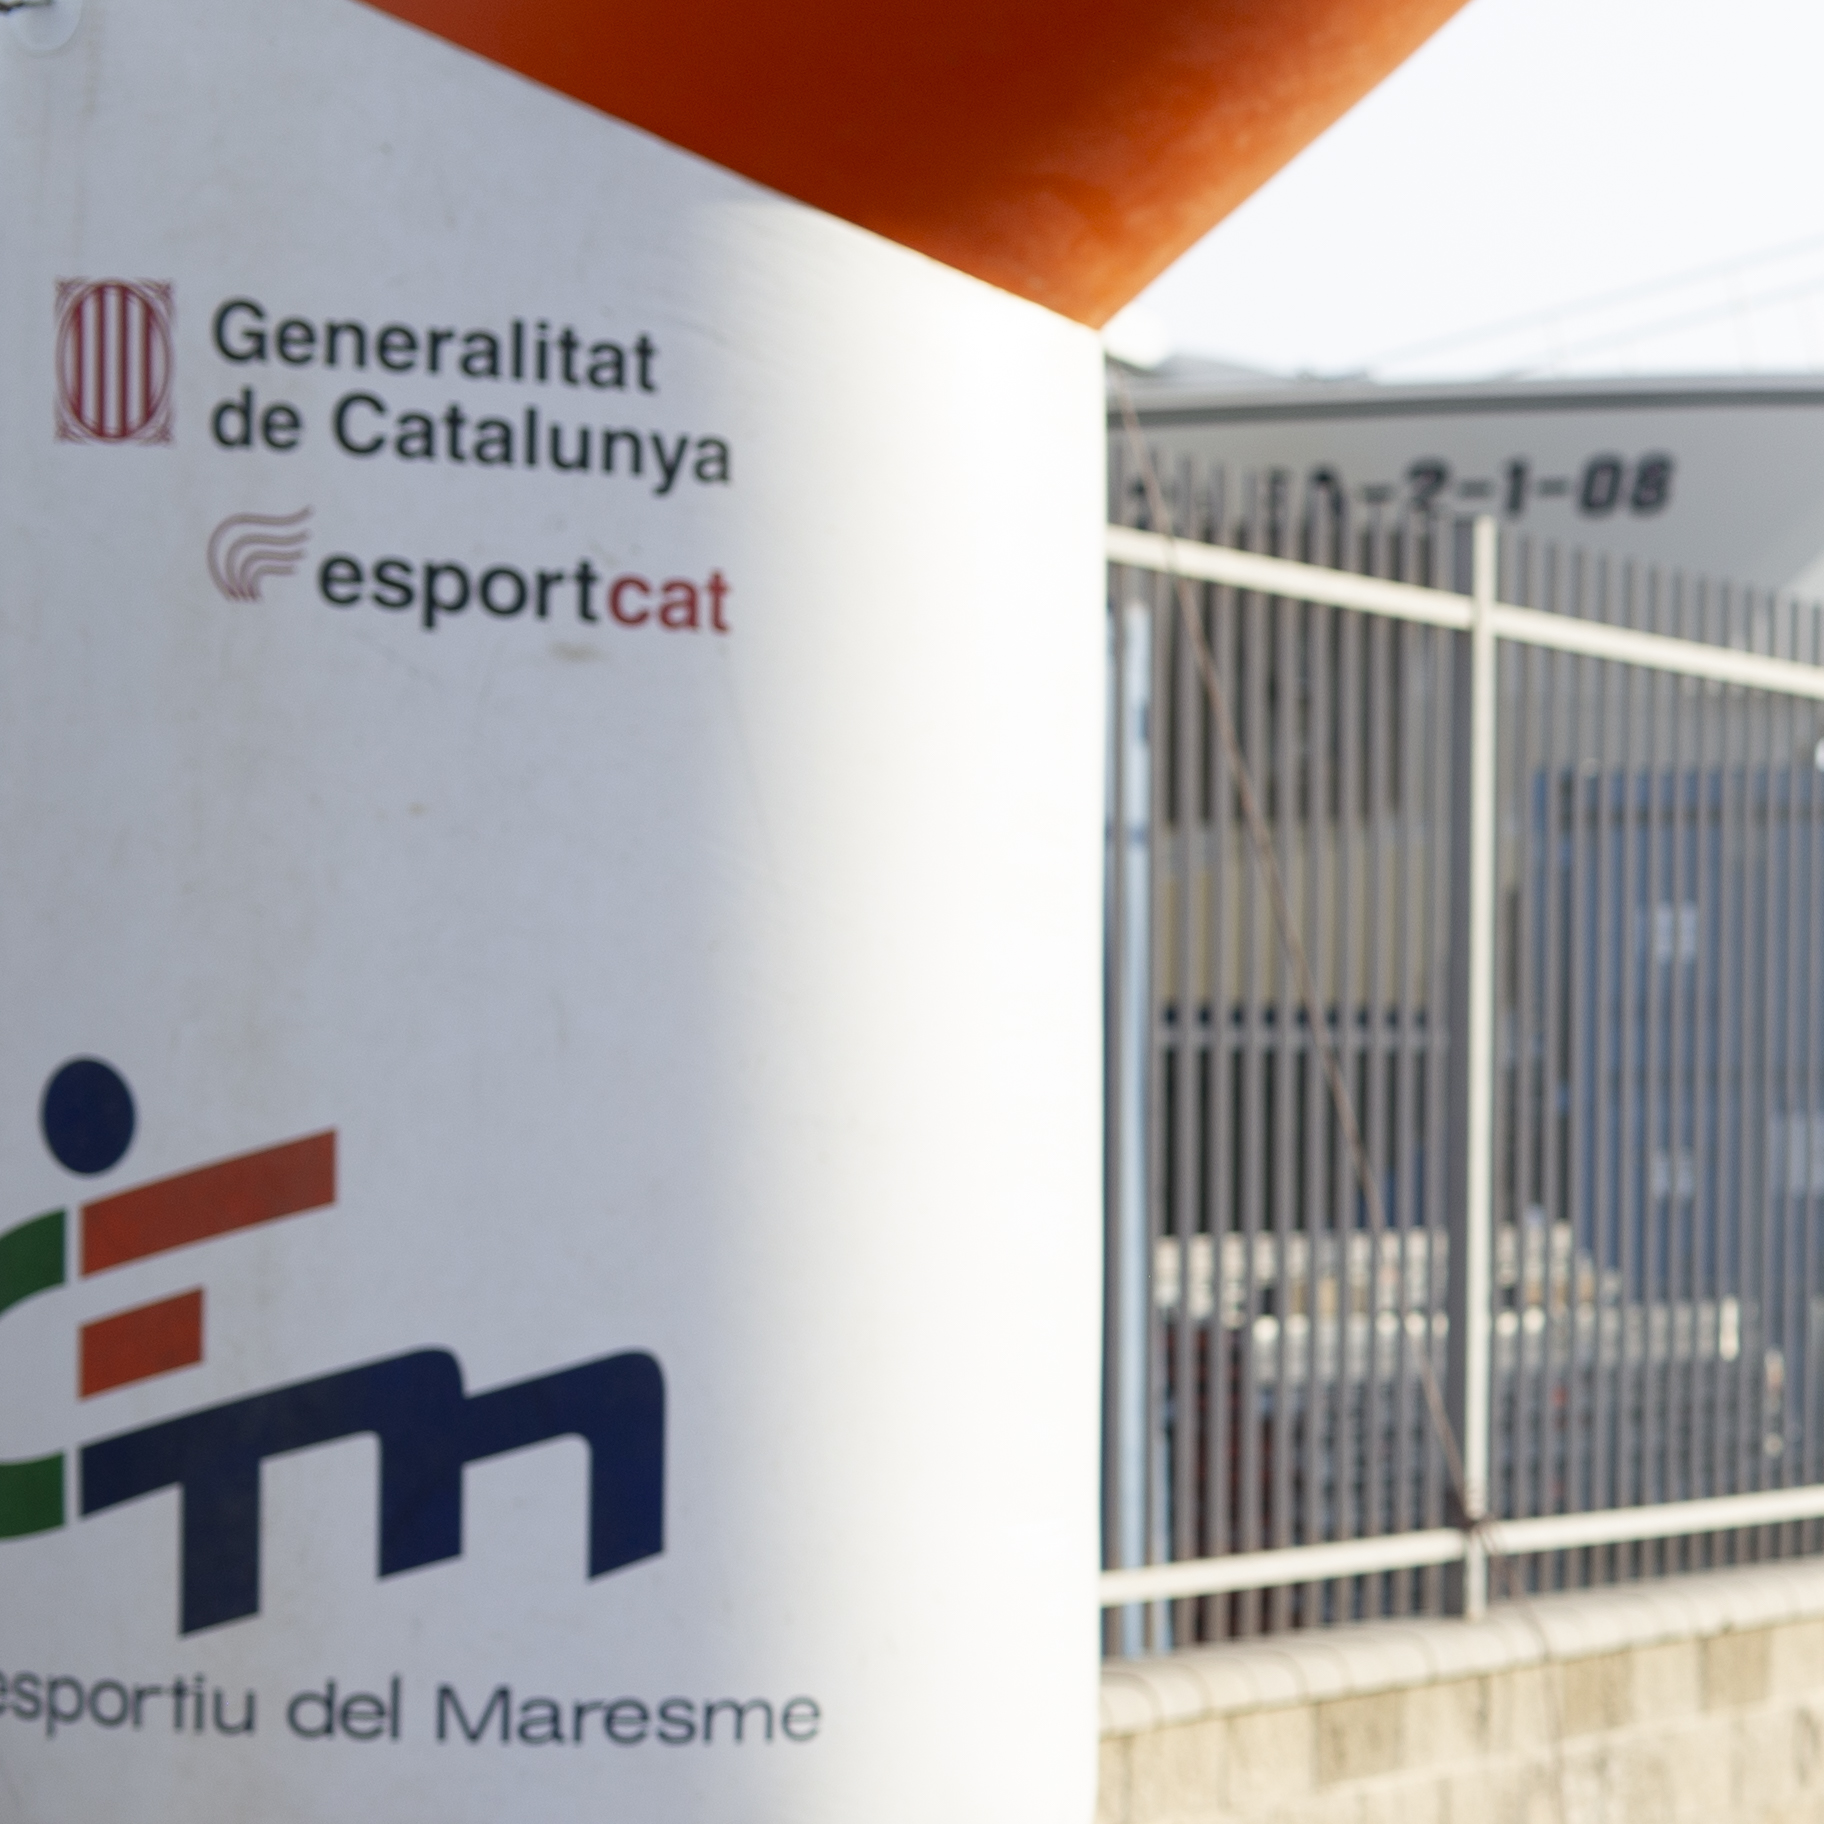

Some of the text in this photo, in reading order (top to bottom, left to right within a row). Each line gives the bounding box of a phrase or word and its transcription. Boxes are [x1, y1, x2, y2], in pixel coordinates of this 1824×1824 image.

[210, 298, 658, 394] Generalitat
[211, 386, 733, 497] de Catalunya
[317, 548, 731, 635] esportcat
[286, 1672, 403, 1742] del
[433, 1682, 823, 1746] Maresme
